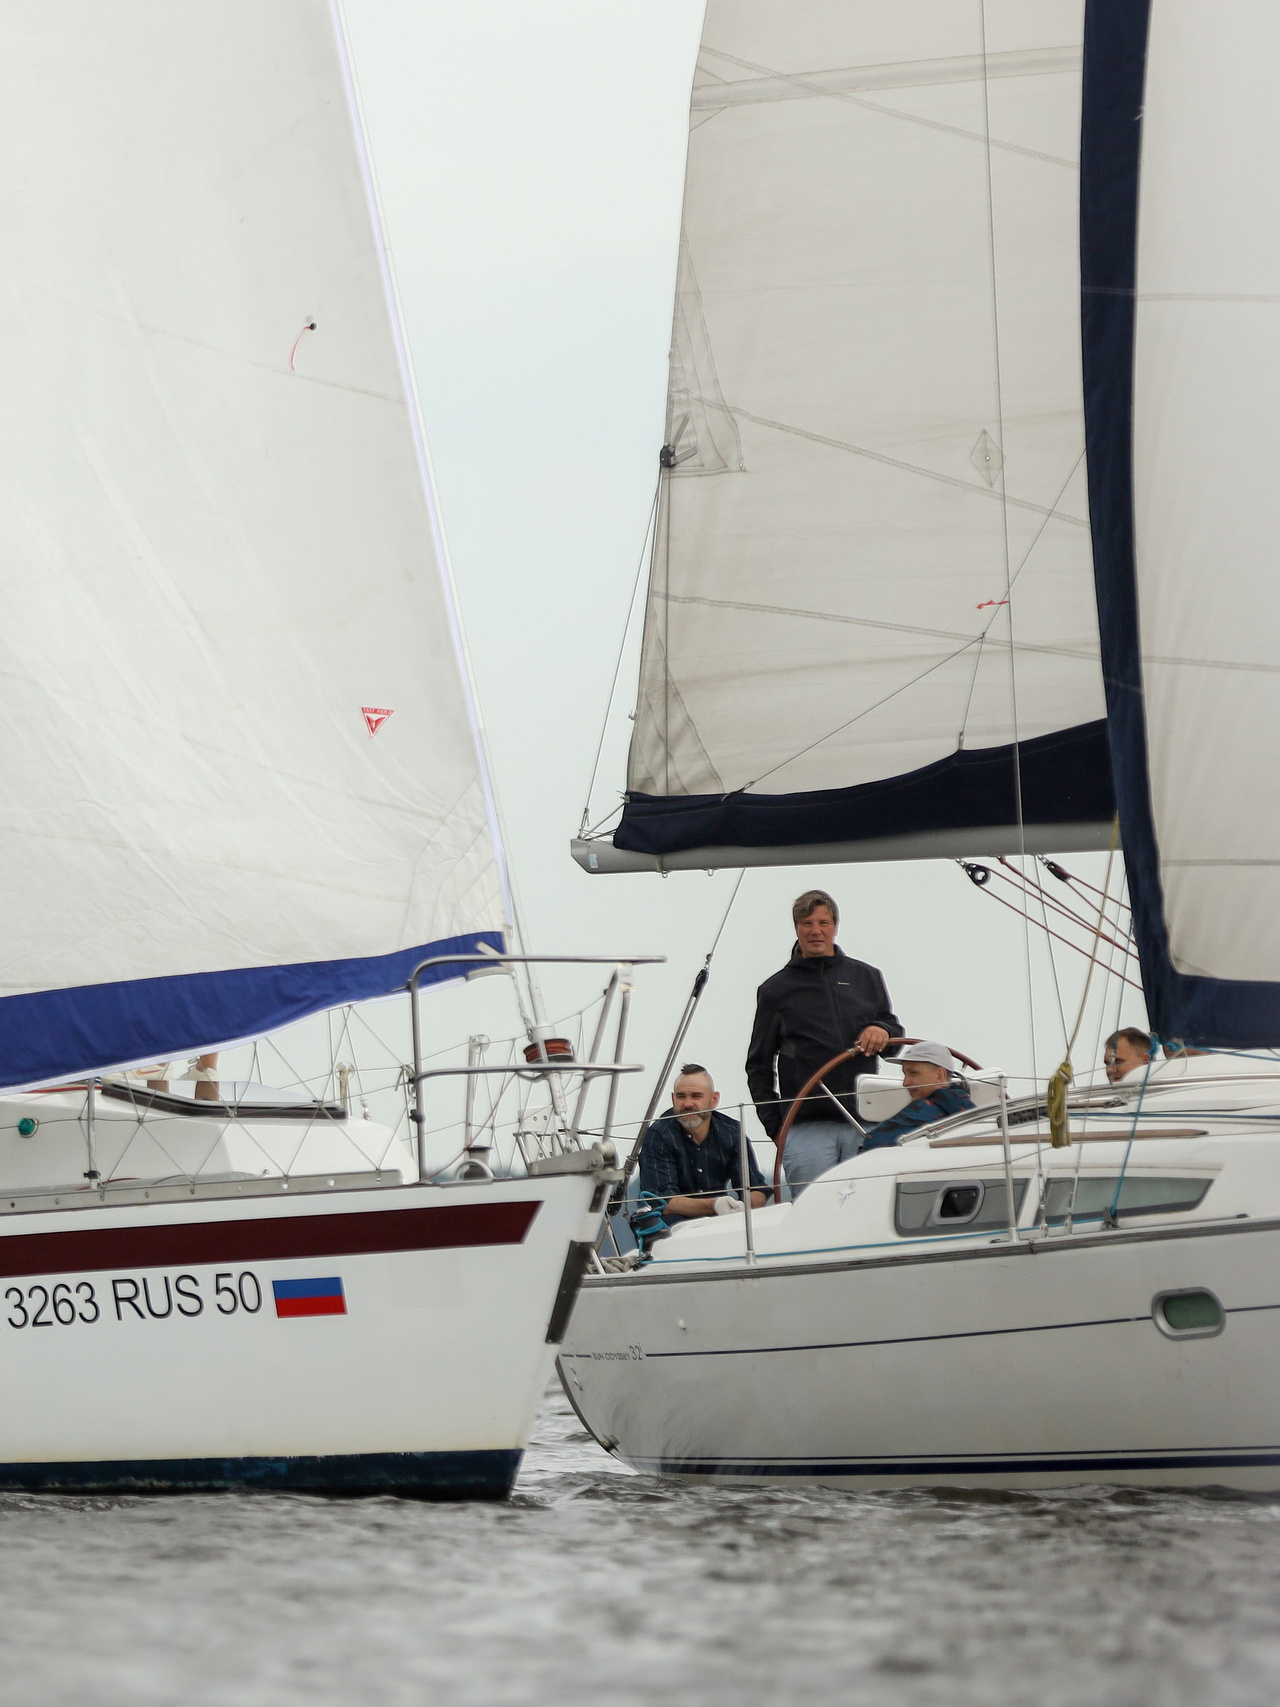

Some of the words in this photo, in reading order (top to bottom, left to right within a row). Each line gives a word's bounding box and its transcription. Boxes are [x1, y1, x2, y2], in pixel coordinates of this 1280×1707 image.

[5, 1281, 101, 1330] 3263
[111, 1274, 205, 1321] RUS
[215, 1271, 262, 1315] 50
